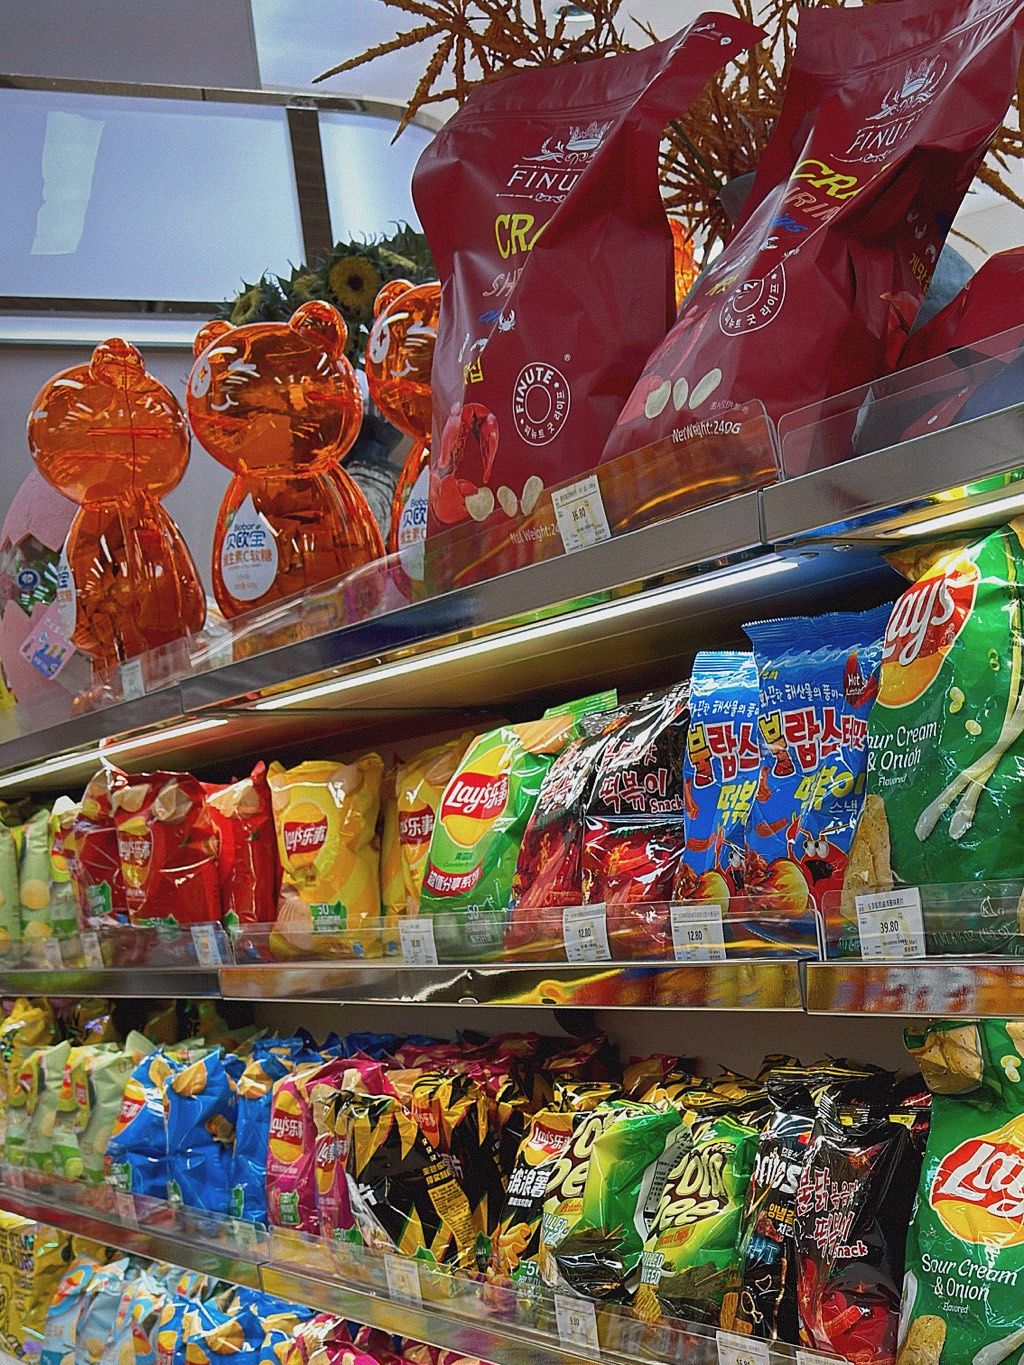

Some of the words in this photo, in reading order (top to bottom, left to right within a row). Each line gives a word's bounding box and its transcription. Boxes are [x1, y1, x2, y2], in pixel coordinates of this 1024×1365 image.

[514, 366, 555, 414] FINUTE
[227, 530, 266, 549] 贝欧宝
[896, 720, 938, 748] Cream
[867, 752, 877, 772] &
[881, 745, 922, 770] Onion
[878, 773, 908, 787] Flavored
[650, 797, 684, 813] Snack
[687, 931, 703, 941] 12.80
[879, 920, 900, 934] 39.80
[921, 1253, 957, 1275] Sour
[958, 1257, 1018, 1287] Cream
[933, 1280, 945, 1296] &
[945, 1279, 991, 1301] Onion
[942, 1302, 970, 1315] Flavored
